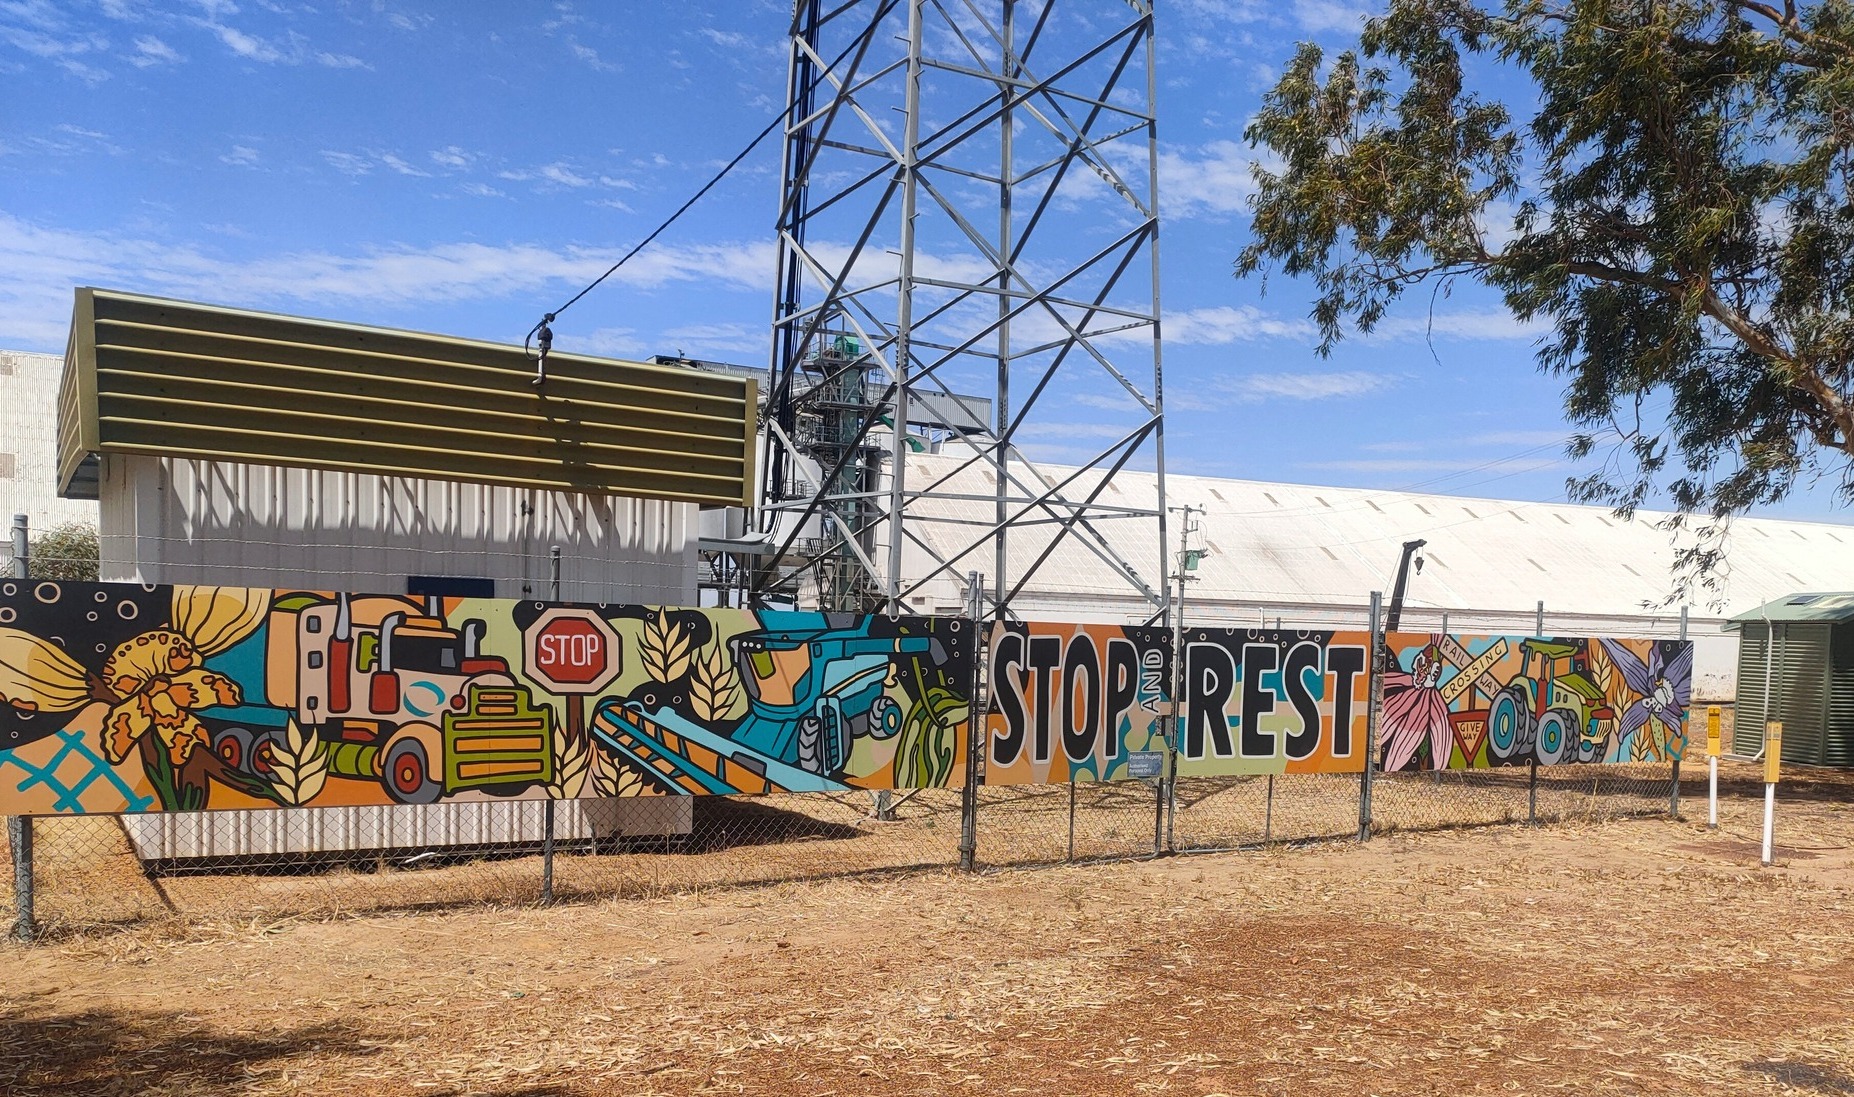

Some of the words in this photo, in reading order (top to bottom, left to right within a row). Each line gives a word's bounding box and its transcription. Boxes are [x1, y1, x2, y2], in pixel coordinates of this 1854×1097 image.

[540, 634, 599, 666] STOP
[1442, 639, 1465, 667] RAIL
[1480, 675, 1500, 696] WAY
[1443, 644, 1503, 700] CROSSING
[990, 632, 1139, 766] STOP
[1140, 648, 1164, 716] AND
[1184, 642, 1366, 760] REST
[1460, 722, 1480, 732] GIVE
[1462, 732, 1478, 741] WAY
